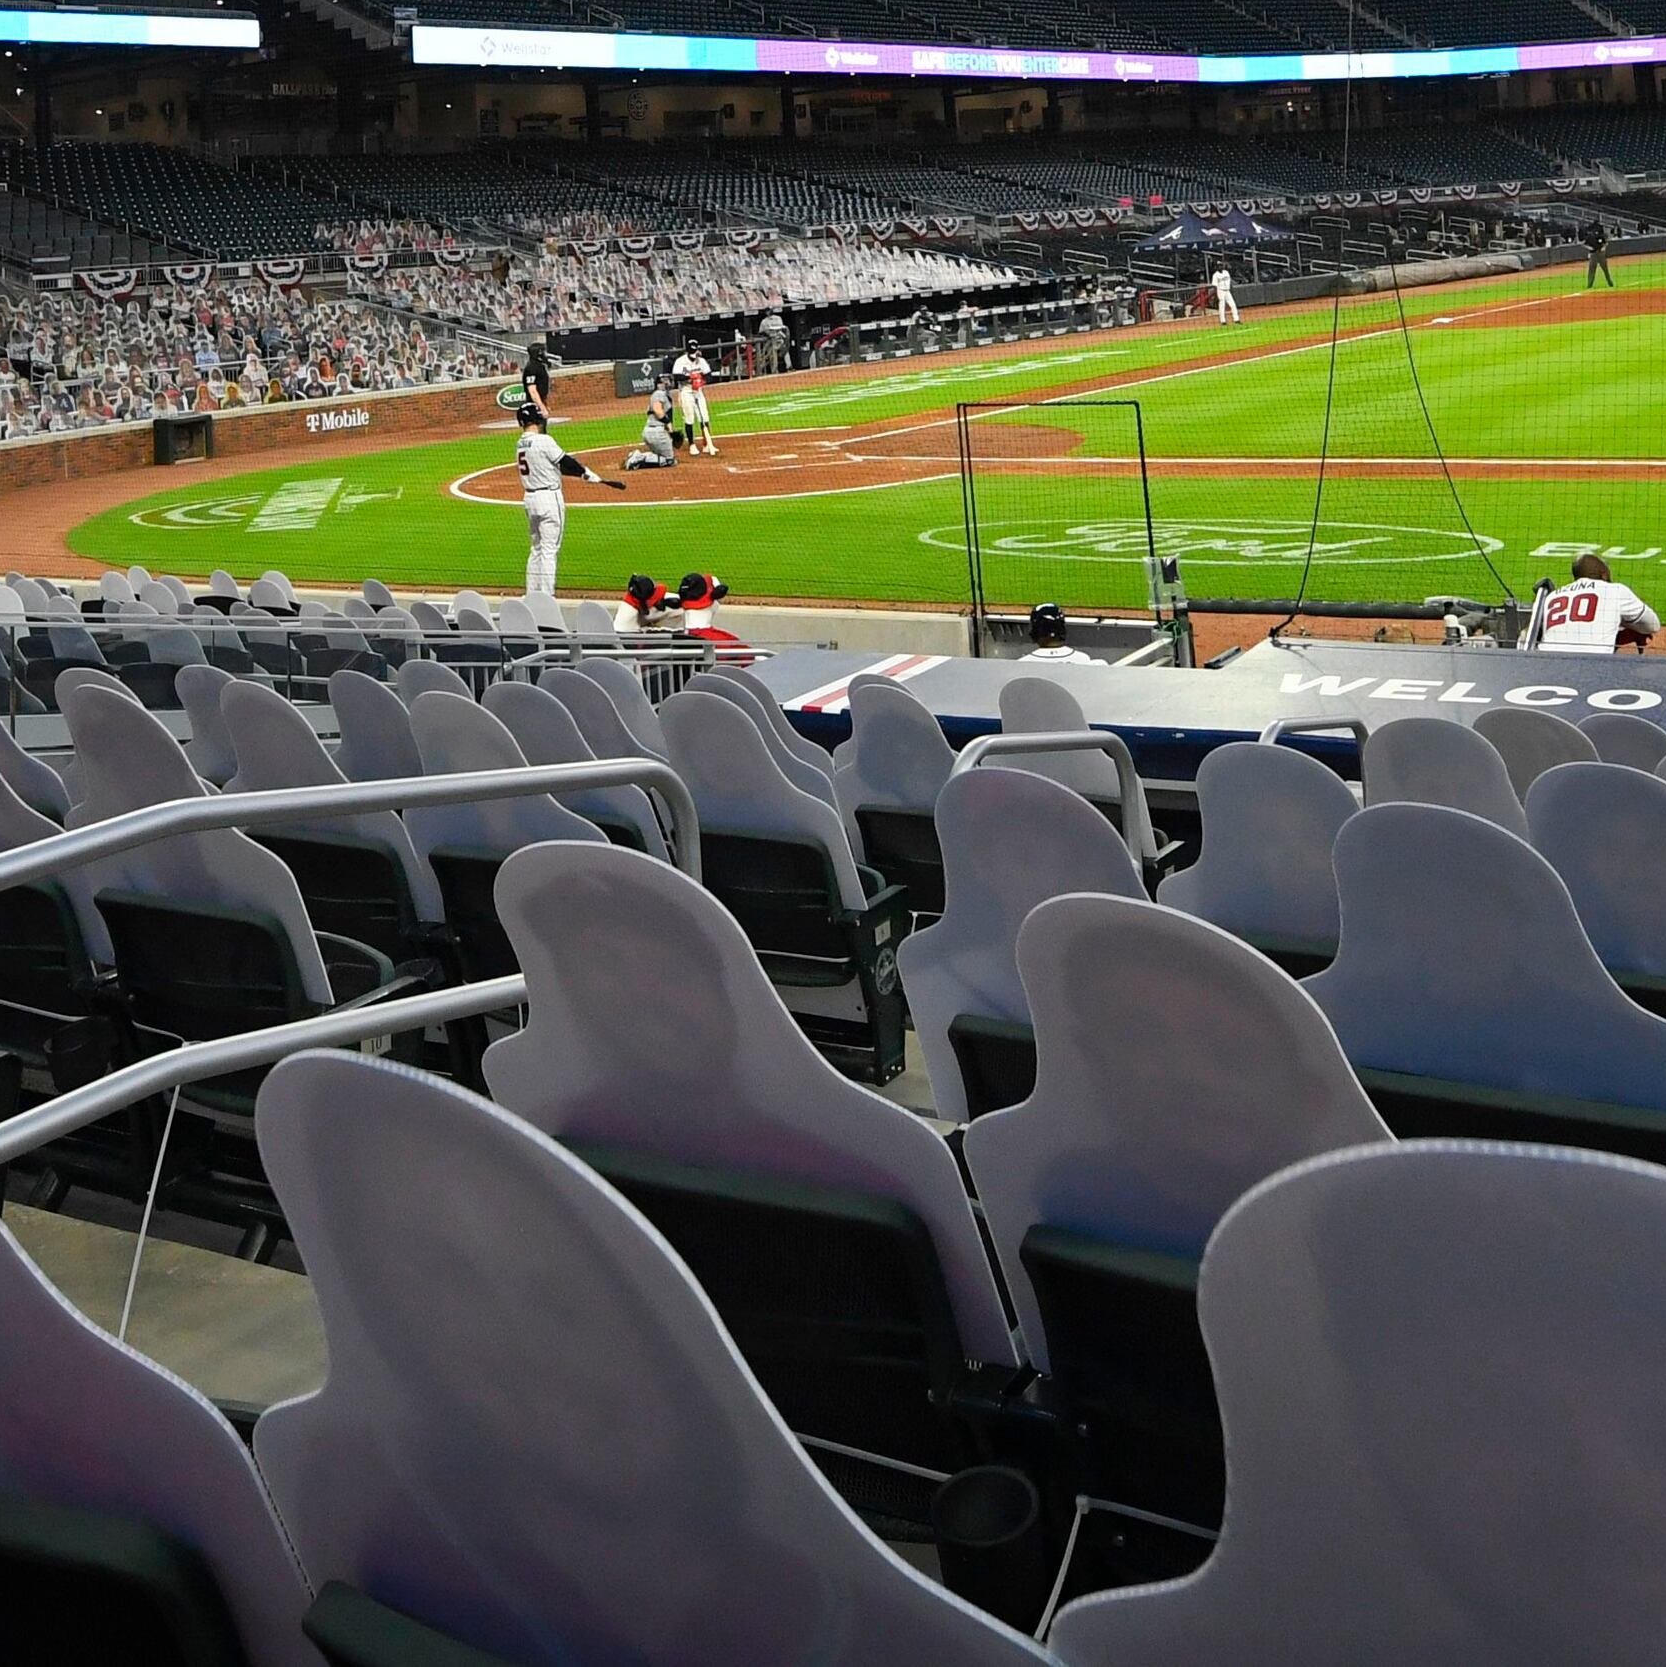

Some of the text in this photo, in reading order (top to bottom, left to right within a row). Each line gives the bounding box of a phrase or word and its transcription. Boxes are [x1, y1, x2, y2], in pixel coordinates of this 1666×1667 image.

[321, 408, 370, 431] Mobile
[518, 451, 530, 476] 5
[1546, 592, 1599, 631] 20
